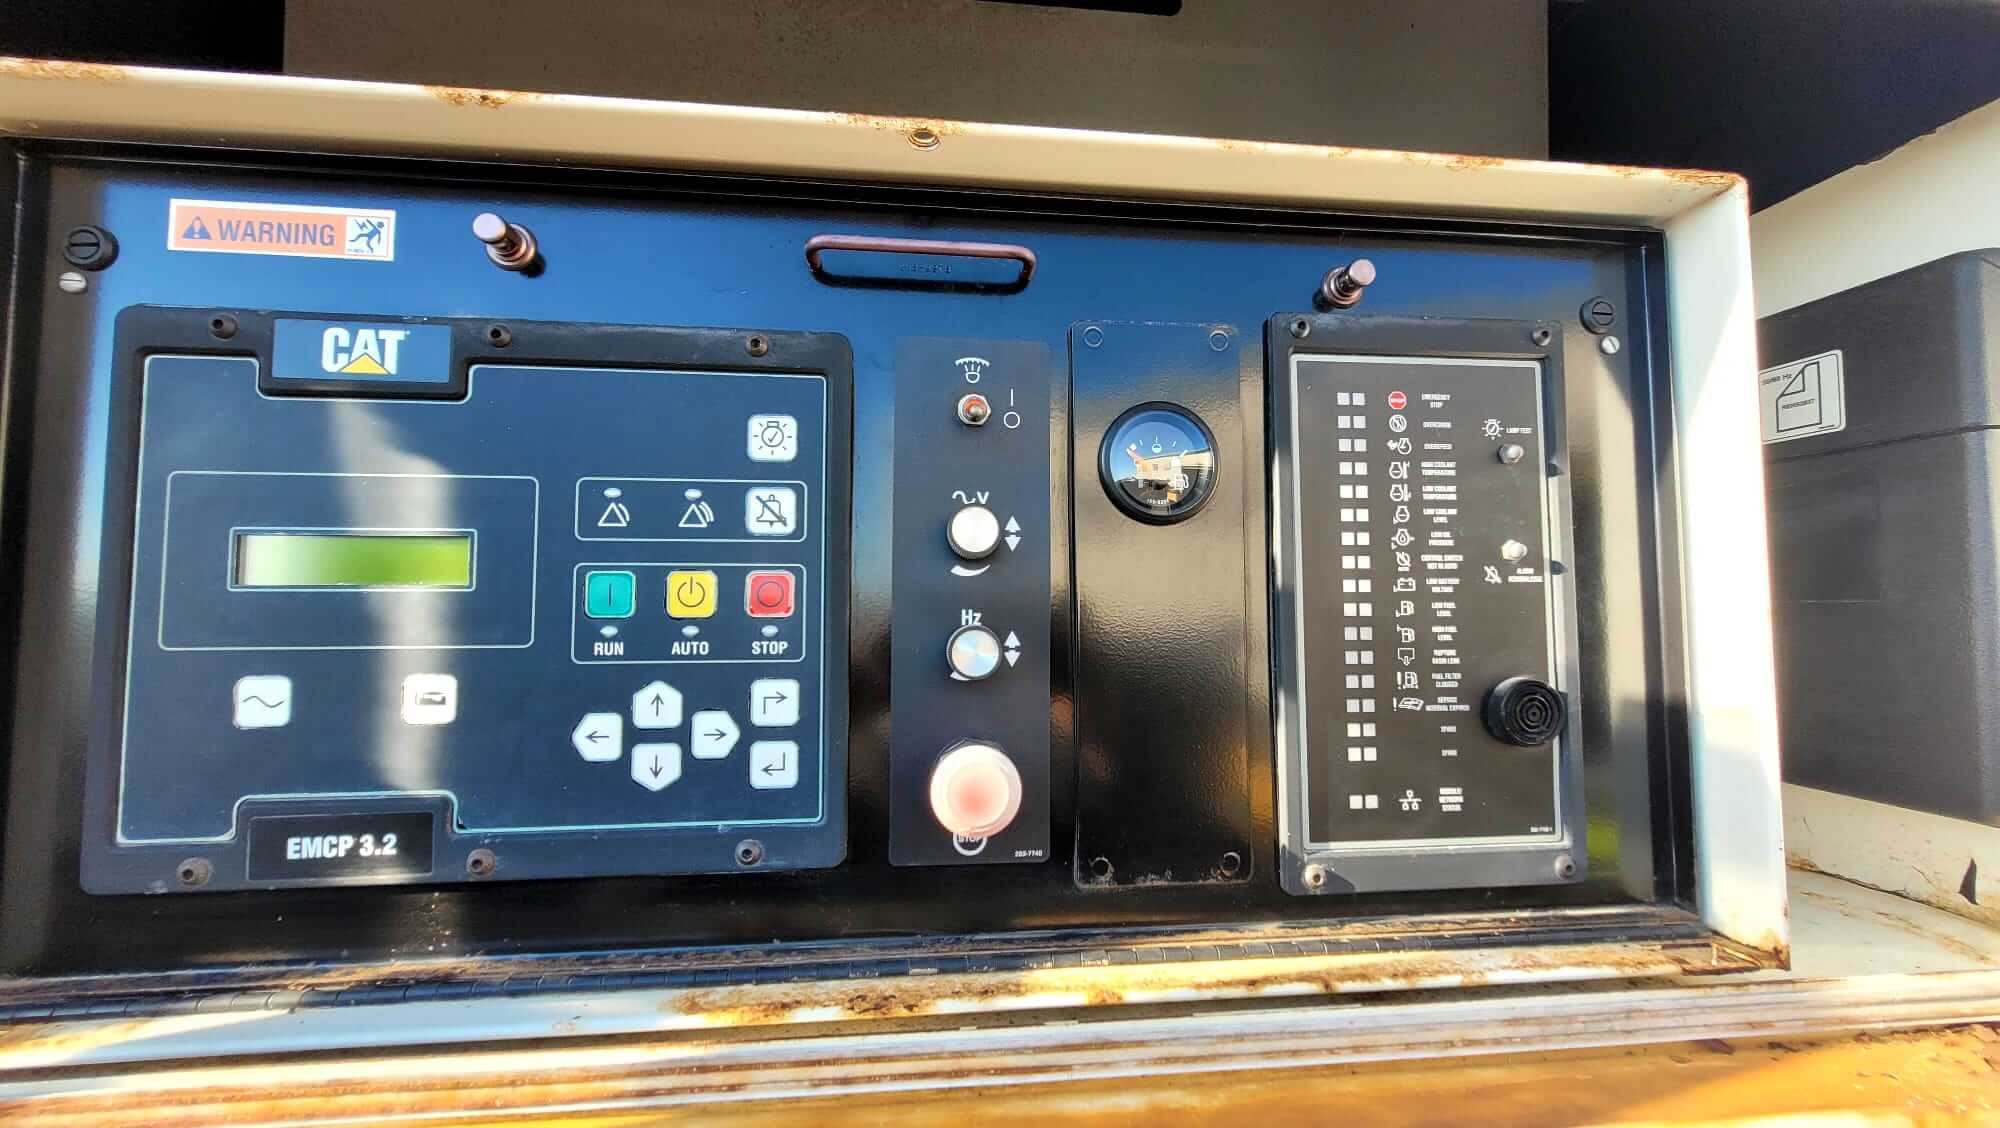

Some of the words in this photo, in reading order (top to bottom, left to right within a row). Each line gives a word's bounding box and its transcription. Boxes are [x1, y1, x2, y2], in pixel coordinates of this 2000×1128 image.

[218, 218, 337, 247] WARNING
[321, 326, 406, 376] CAT
[976, 491, 990, 505] V
[961, 608, 983, 626] Hz
[593, 641, 625, 657] RUN
[671, 641, 710, 656] AUTO
[751, 640, 789, 655] STOP
[286, 834, 355, 860] EMCP
[359, 832, 398, 857] 3.2
